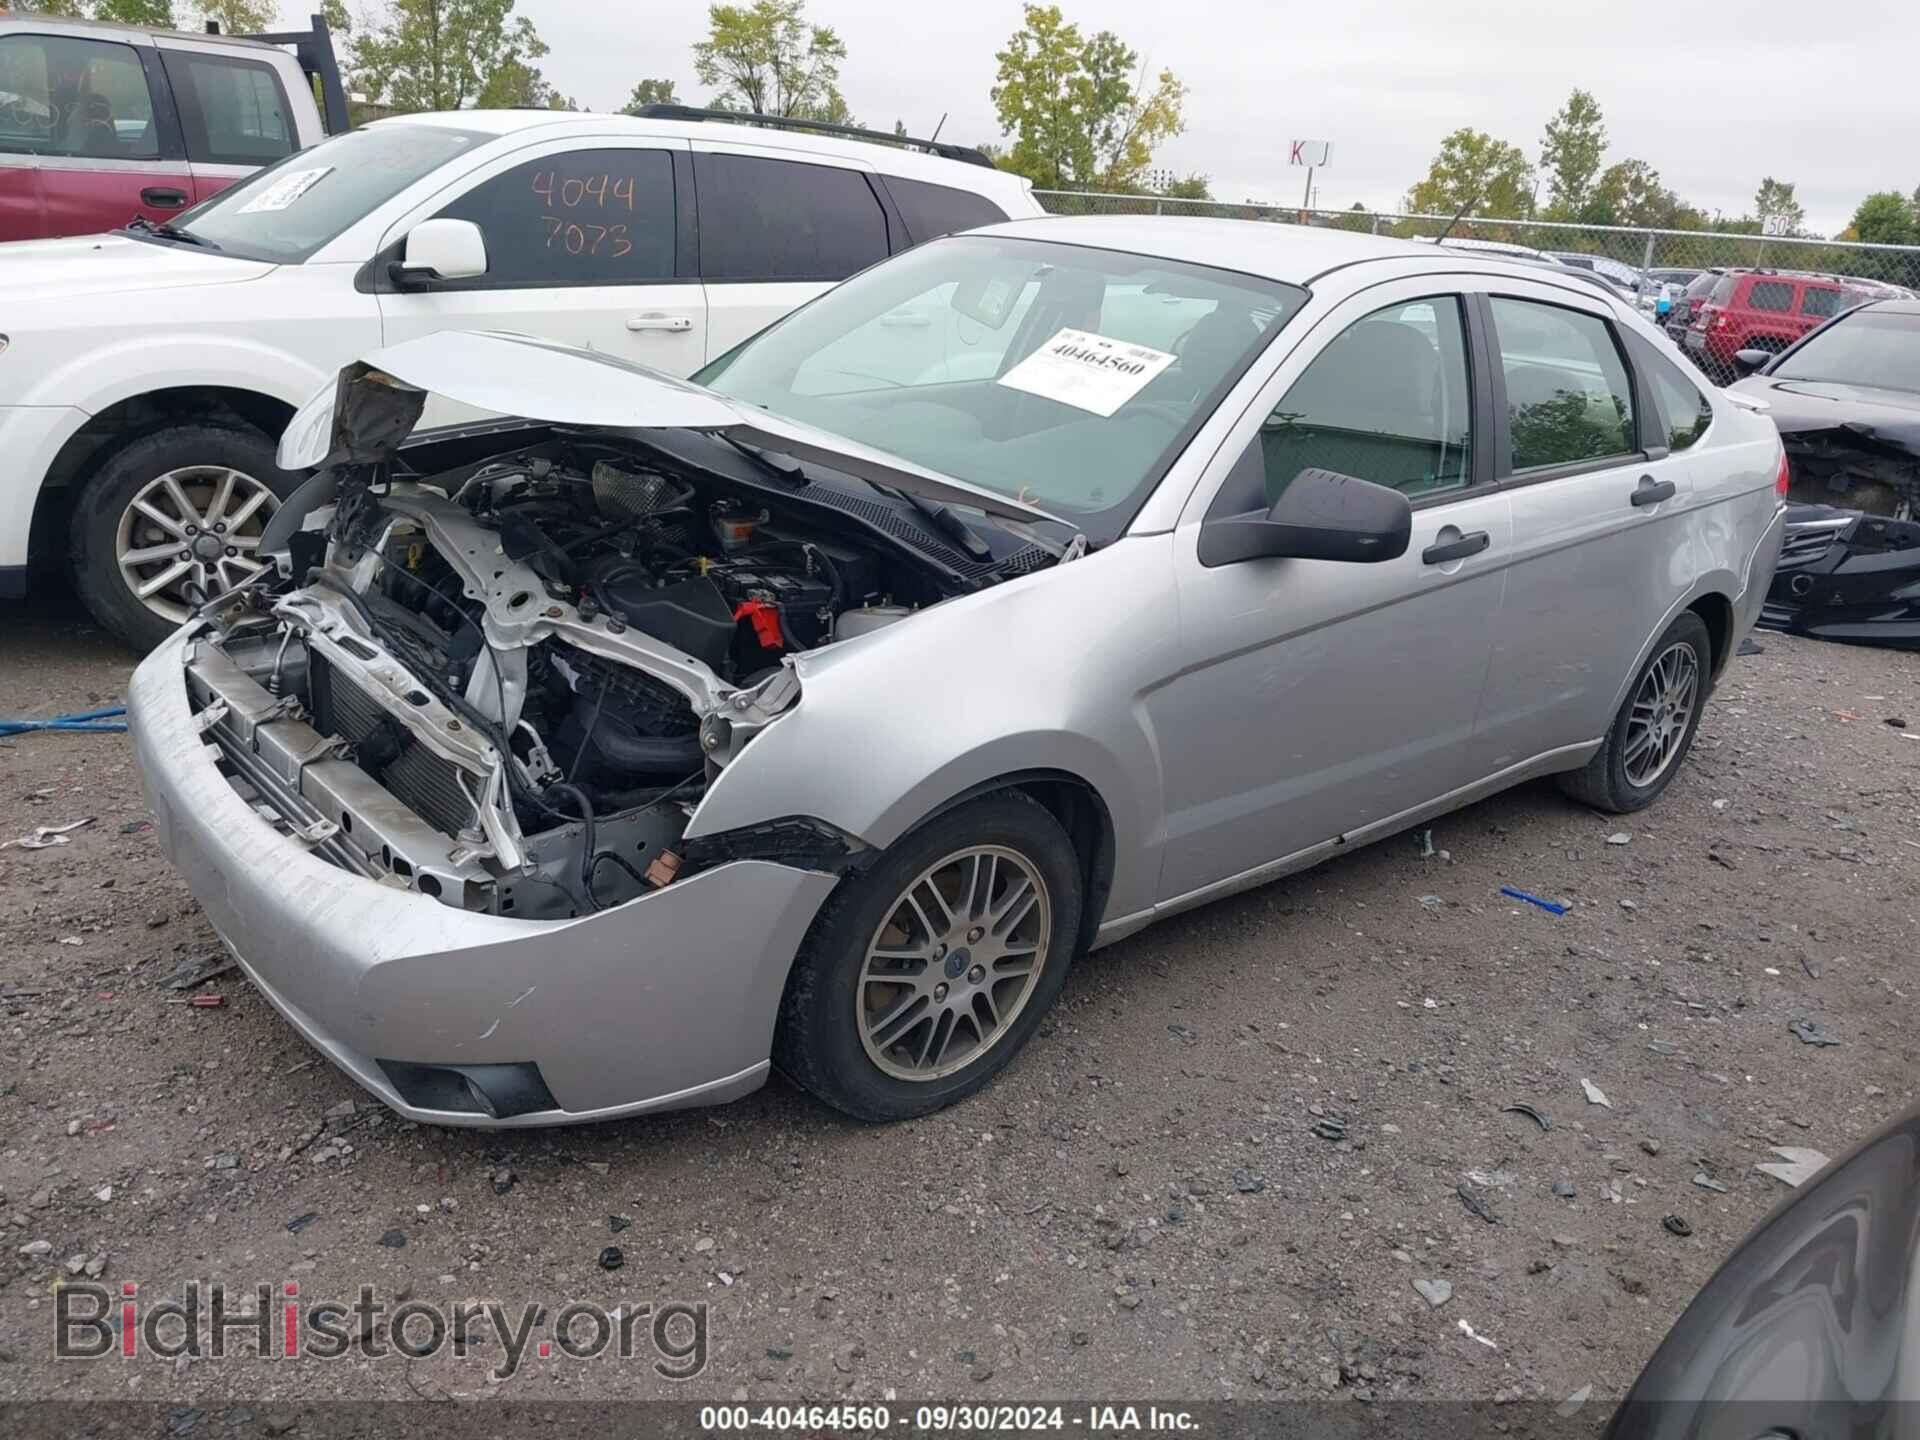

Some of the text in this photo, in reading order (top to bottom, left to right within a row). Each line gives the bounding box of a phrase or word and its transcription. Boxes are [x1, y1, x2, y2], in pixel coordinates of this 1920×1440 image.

[1290, 139, 1307, 166] K
[540, 215, 633, 258] 7073
[1052, 343, 1147, 376] 40464560
